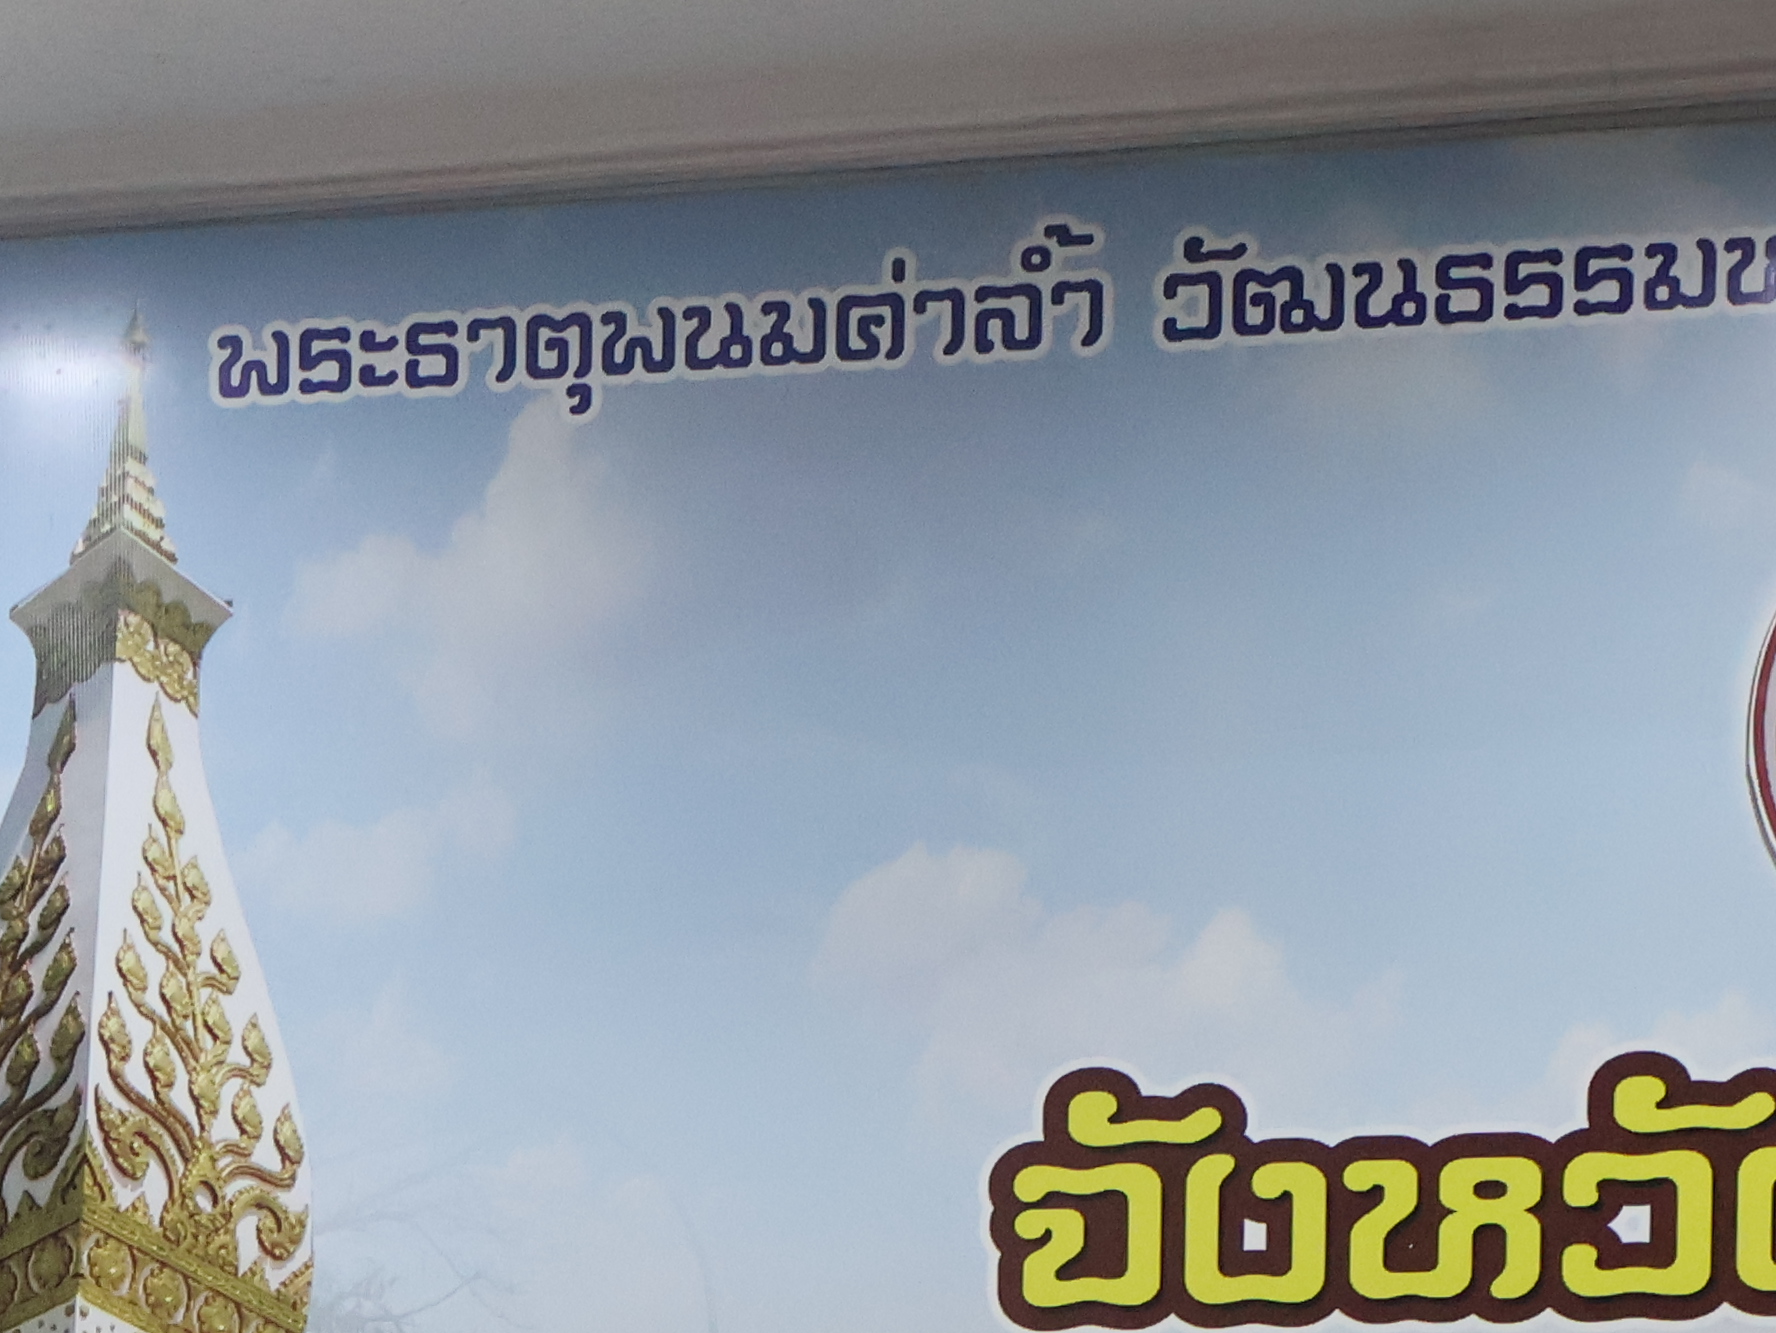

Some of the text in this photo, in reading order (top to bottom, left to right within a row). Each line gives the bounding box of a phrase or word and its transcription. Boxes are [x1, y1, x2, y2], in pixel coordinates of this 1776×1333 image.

[217, 222, 1105, 416] พระธาตุพนมค่าล้ำ
[1008, 1070, 1776, 1312] จังหวั
